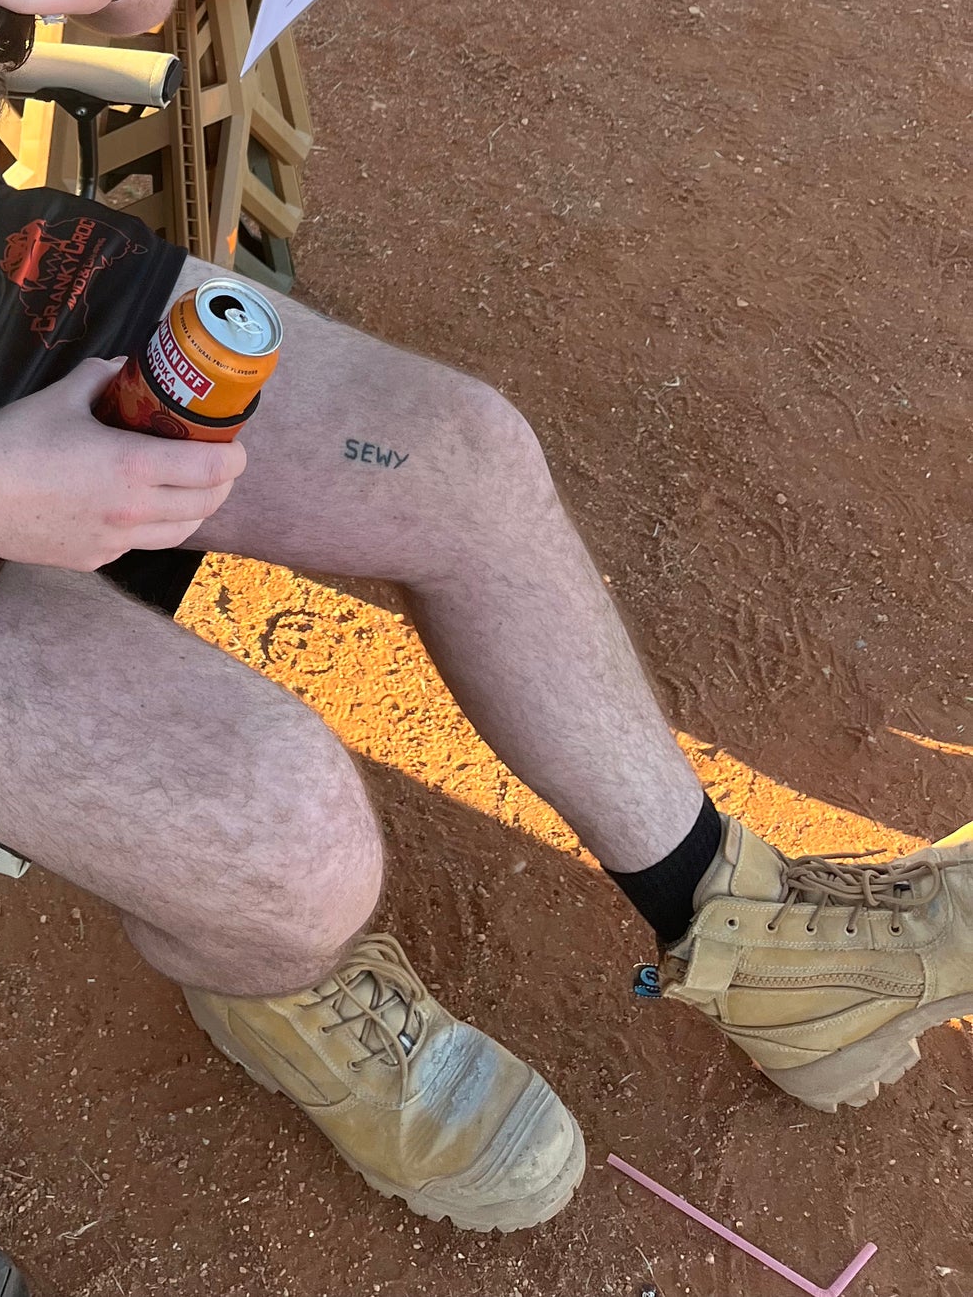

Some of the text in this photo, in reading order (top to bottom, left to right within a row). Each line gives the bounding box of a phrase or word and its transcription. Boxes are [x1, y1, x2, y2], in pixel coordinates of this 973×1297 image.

[153, 343, 176, 387] VODKA
[159, 319, 205, 389] MIRNOFF
[344, 438, 410, 470] SEWY
